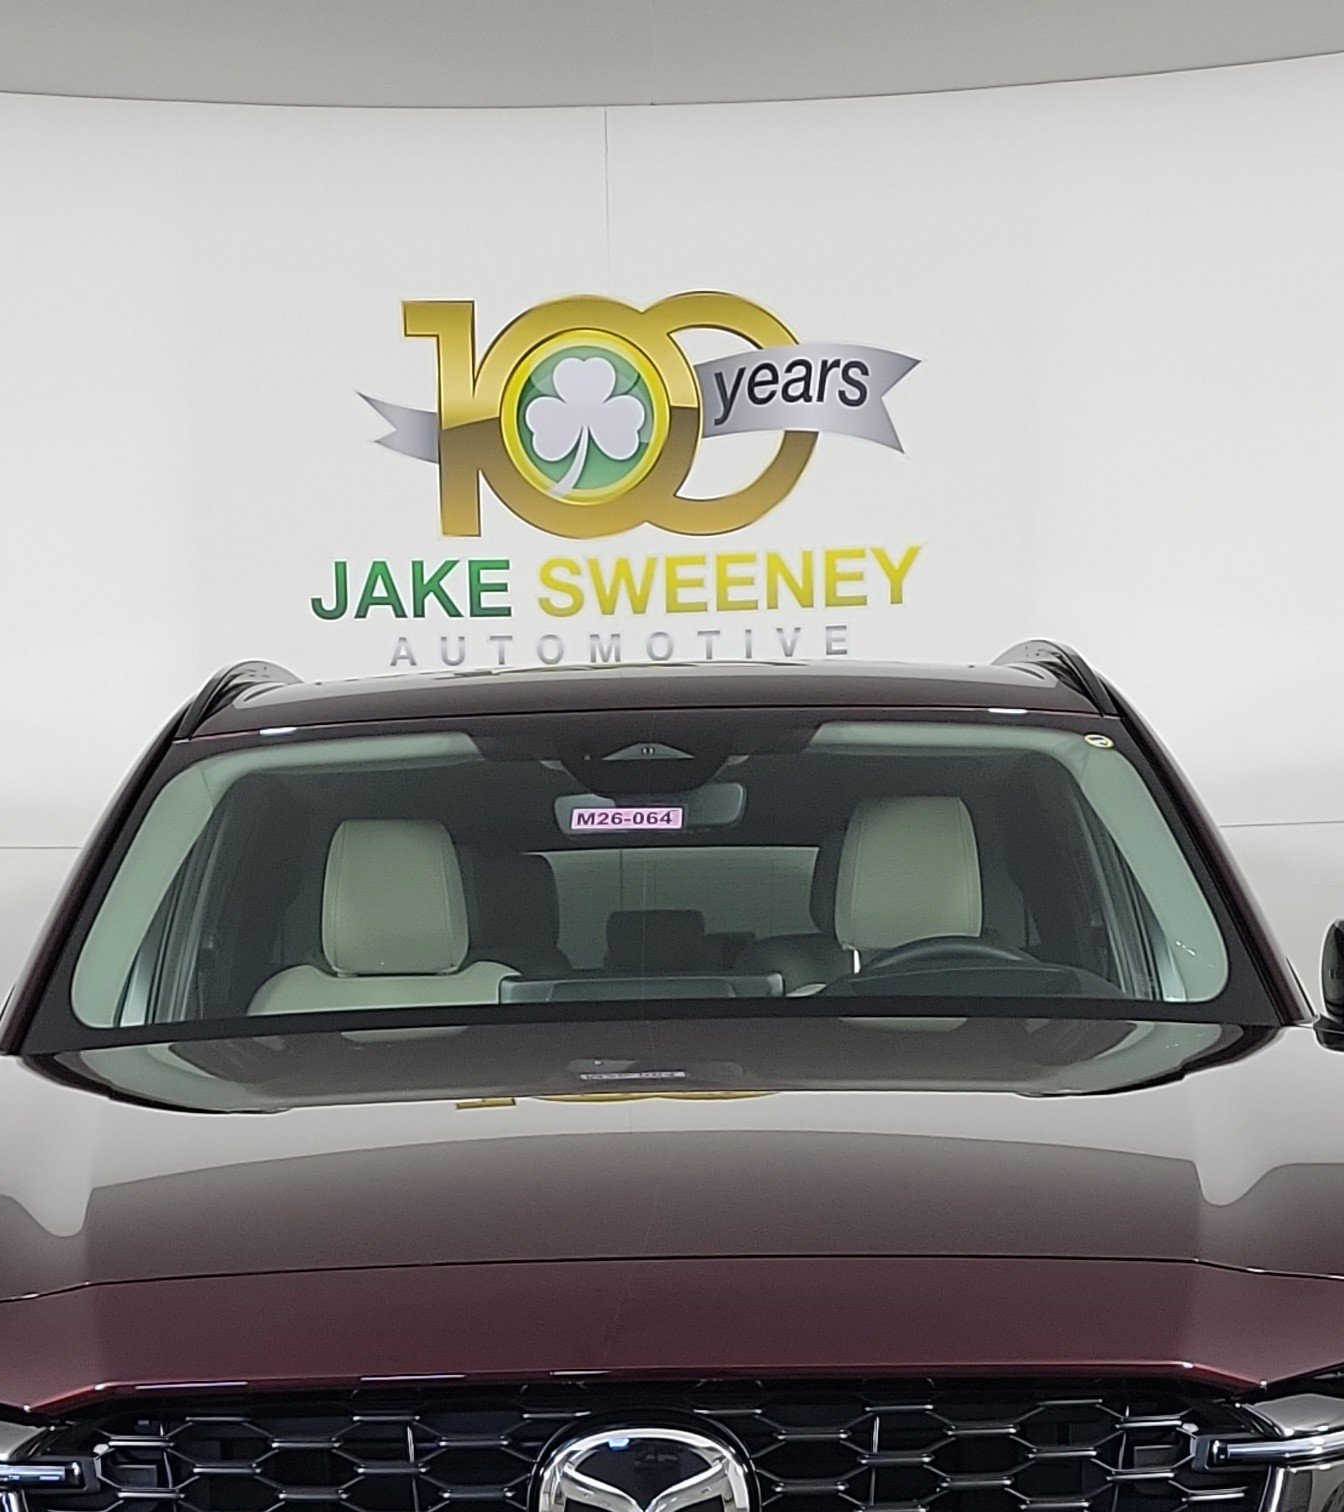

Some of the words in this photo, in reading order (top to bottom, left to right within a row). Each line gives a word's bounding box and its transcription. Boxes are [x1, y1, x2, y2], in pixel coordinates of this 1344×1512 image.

[401, 290, 819, 539] 100
[712, 357, 870, 426] years
[310, 558, 512, 621] JAKE
[537, 545, 923, 618] SWEENEY
[389, 624, 849, 667] AUTOMOTIVE
[576, 810, 673, 826] M26-064
